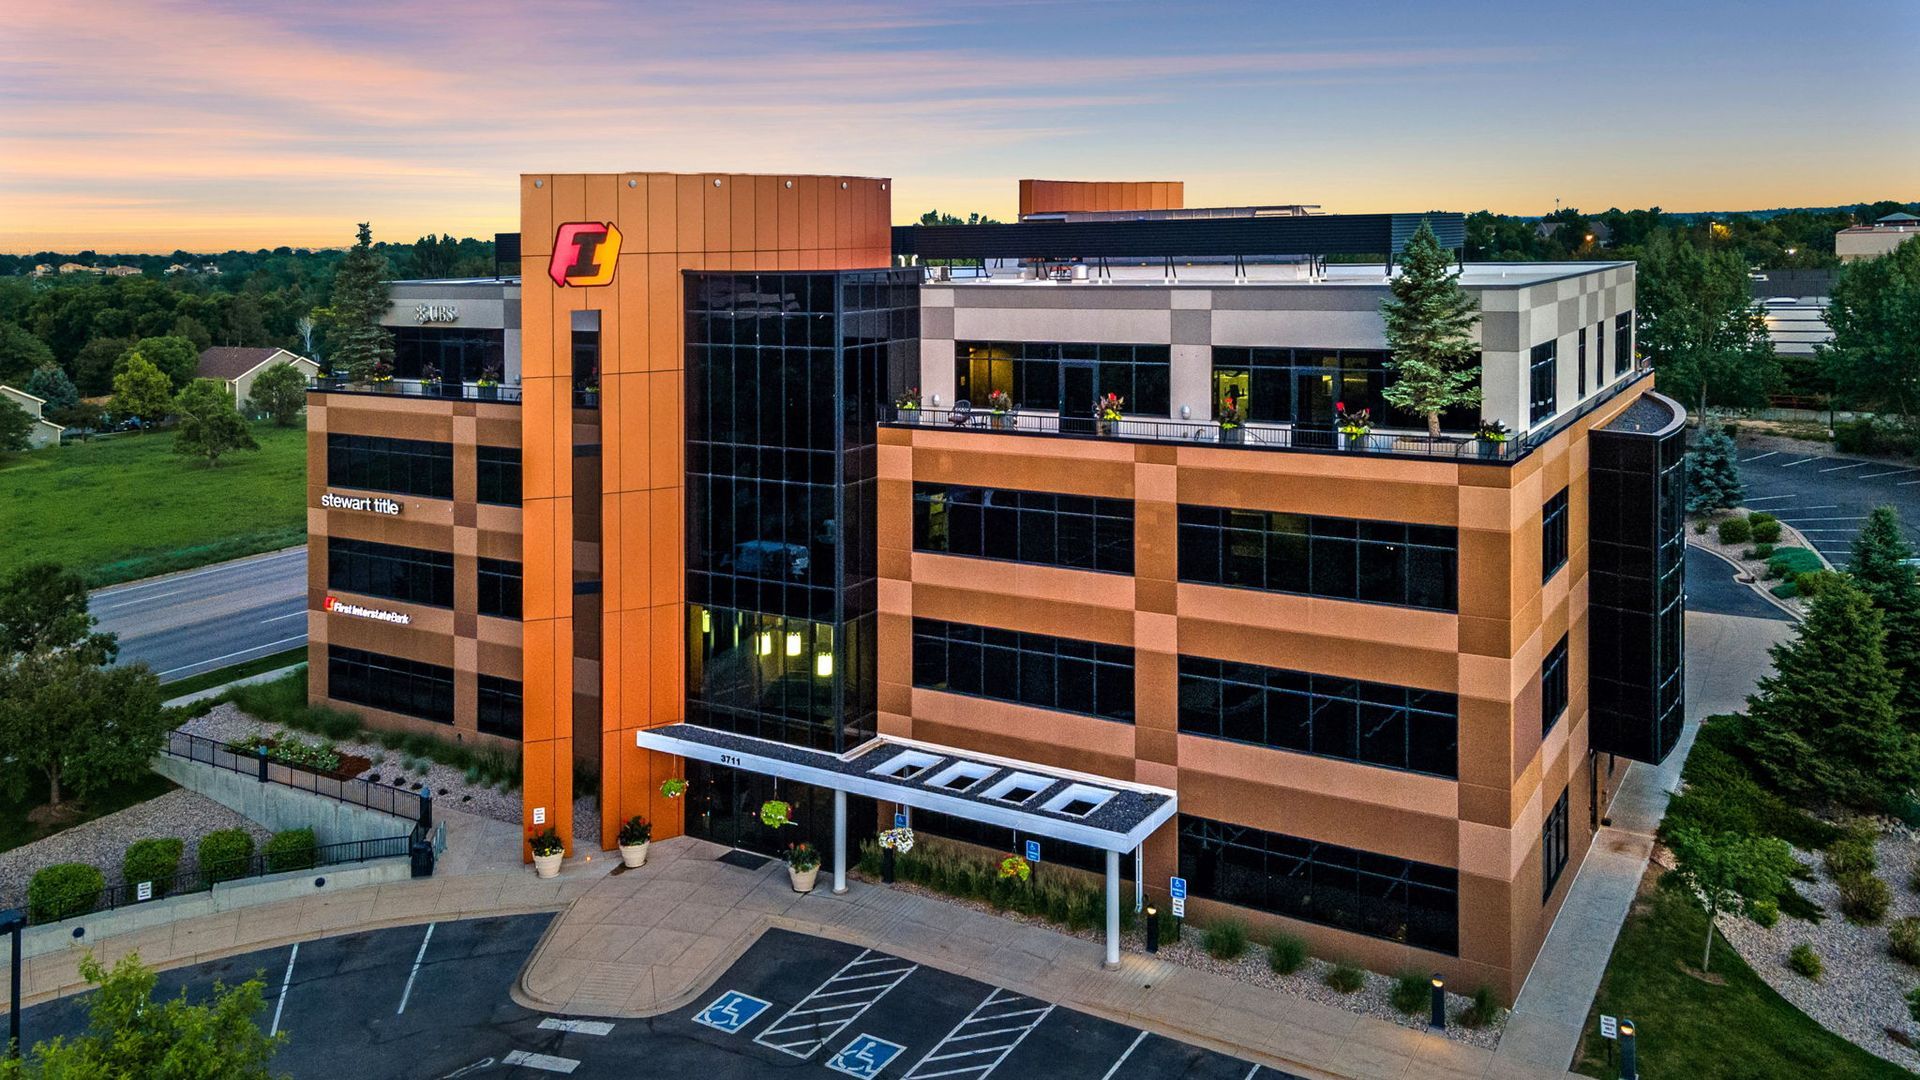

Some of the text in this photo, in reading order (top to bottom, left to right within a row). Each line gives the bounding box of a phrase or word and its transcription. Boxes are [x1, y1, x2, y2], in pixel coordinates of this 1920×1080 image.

[430, 305, 455, 321] UBS
[321, 493, 399, 515] stewart title
[334, 602, 352, 614] First
[720, 754, 740, 766] 3711
